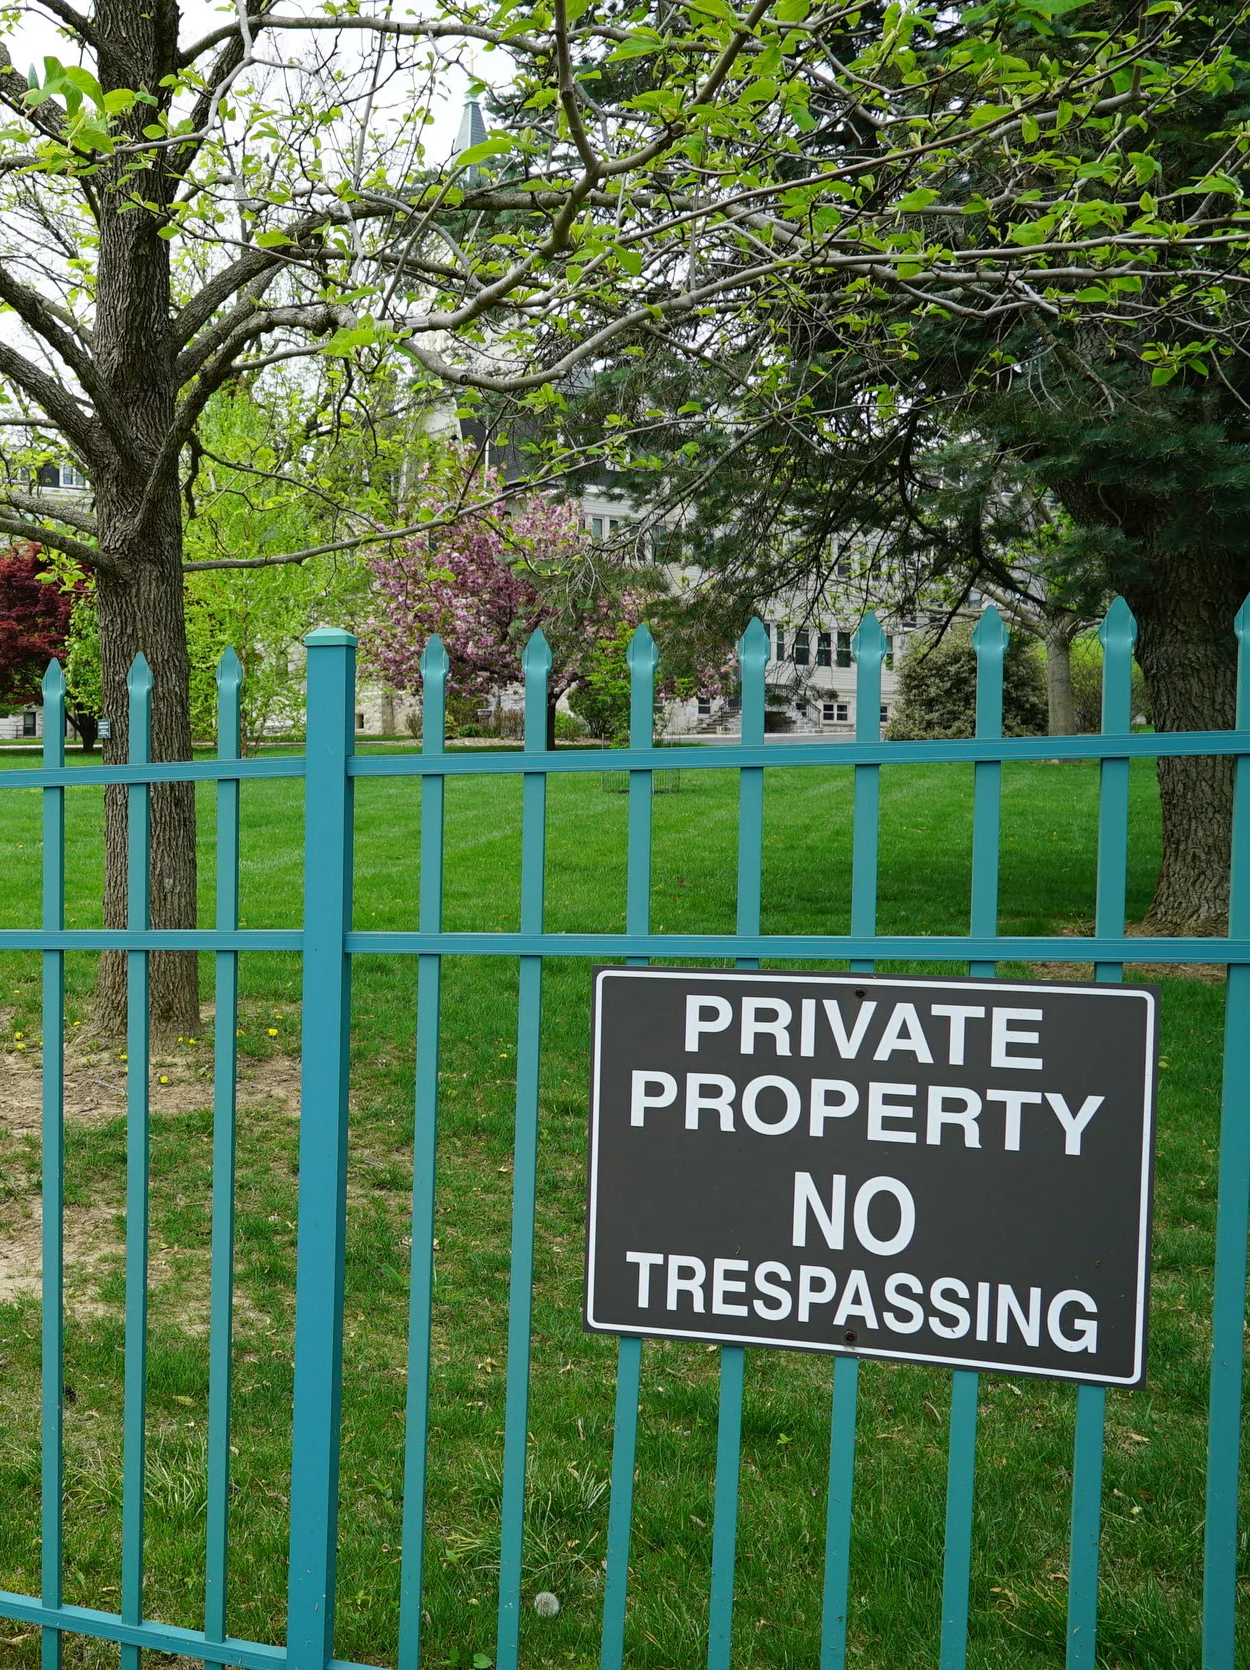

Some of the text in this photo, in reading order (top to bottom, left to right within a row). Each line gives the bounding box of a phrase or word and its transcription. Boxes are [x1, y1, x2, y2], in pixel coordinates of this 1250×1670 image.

[684, 994, 1044, 1070] PRIVATE
[630, 1069, 1105, 1156] PROPERTY
[792, 1171, 916, 1256] NO
[625, 1251, 1098, 1354] TRESPASSING
